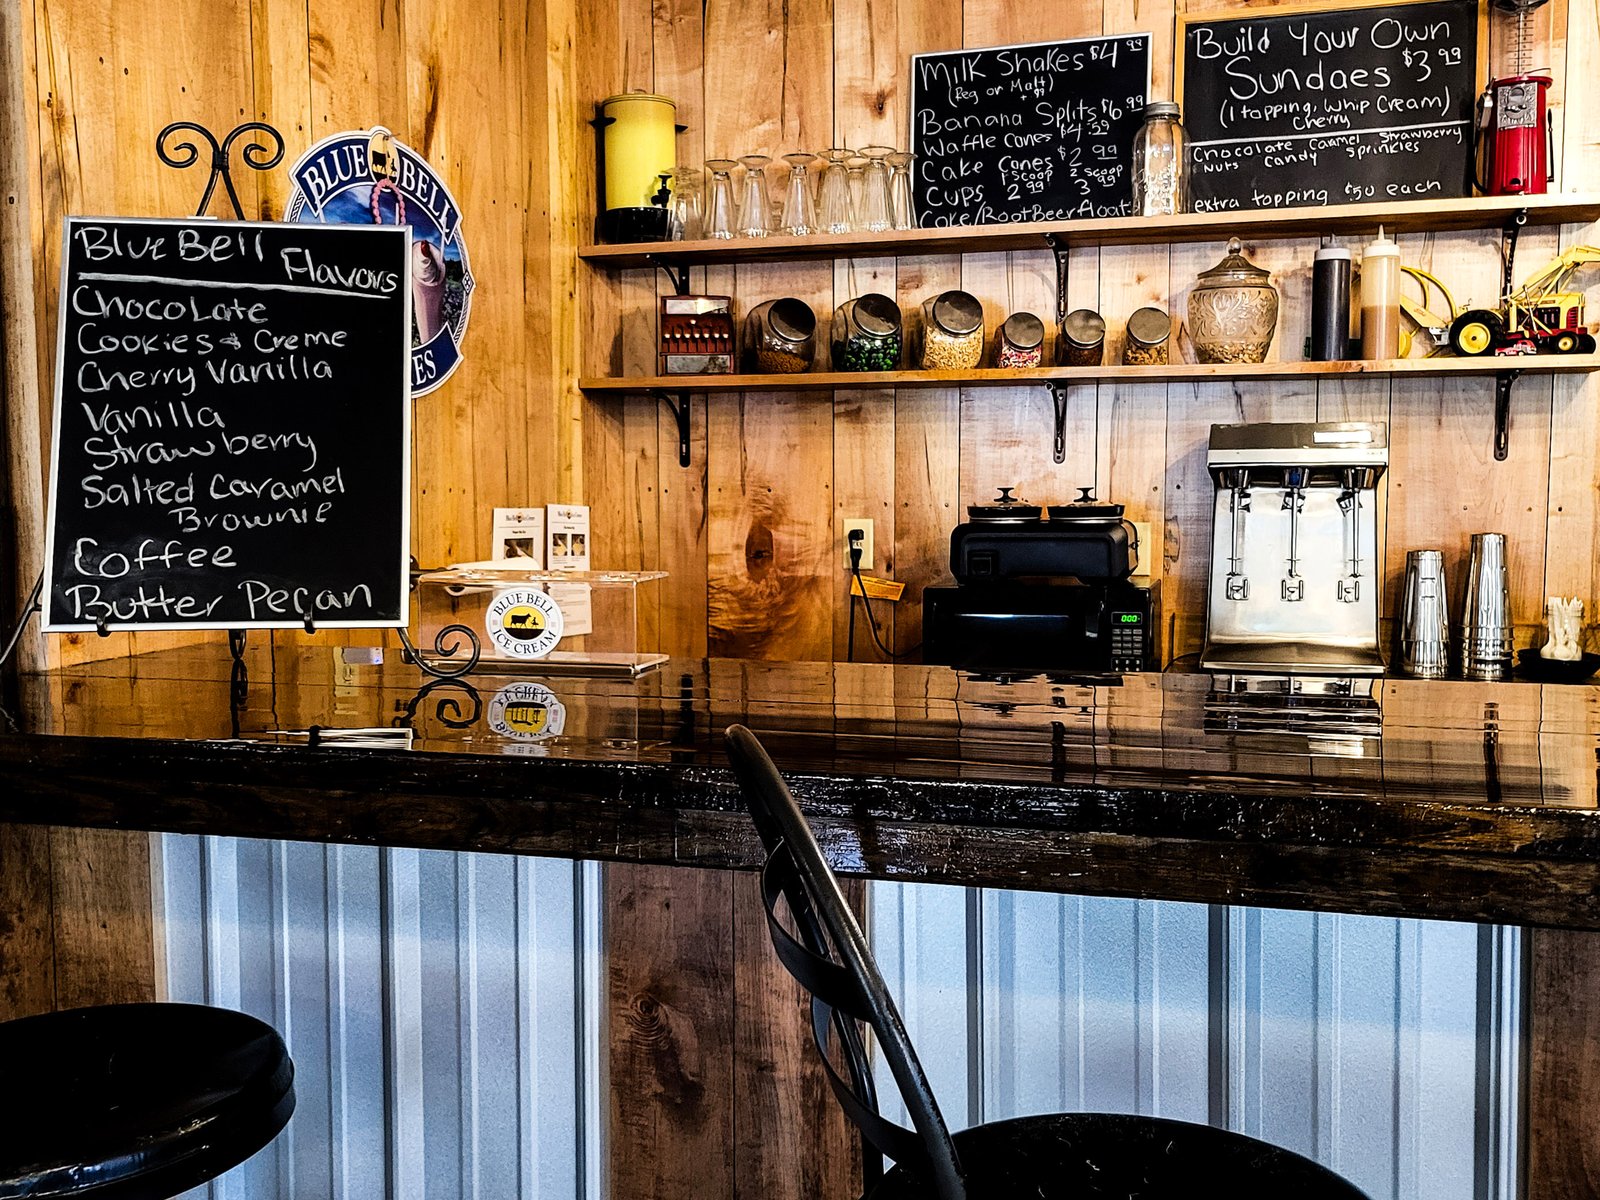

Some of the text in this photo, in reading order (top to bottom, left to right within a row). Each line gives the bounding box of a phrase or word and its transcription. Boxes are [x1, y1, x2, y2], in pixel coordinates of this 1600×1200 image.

[1192, 18, 1450, 60] Build Your Own
[986, 86, 1004, 96] or
[1224, 56, 1391, 100] Sundaes
[918, 108, 1022, 135] Banana
[1035, 99, 1097, 128] Splits
[1293, 113, 1350, 130] Cherry
[922, 133, 997, 157] Waffle
[1193, 140, 1293, 164] Chocolate
[922, 157, 983, 183] Cake
[998, 155, 1054, 173] Cones
[1070, 168, 1078, 177] 2
[301, 144, 454, 234] BLUE BELL
[1194, 198, 1240, 214] extra
[1252, 189, 1328, 207] topping
[1386, 180, 1441, 196] each
[75, 226, 399, 293] Blue Bell Flavors
[78, 323, 214, 355] Cookies
[253, 328, 348, 354] Creme
[77, 354, 334, 396] Cherry Vanilla
[80, 400, 226, 435] Vanilla
[83, 431, 317, 473] Strawberry
[80, 466, 346, 509] Salted Caramel
[168, 500, 333, 533] Brownie
[73, 537, 237, 579] Coffee
[64, 579, 372, 621] Butter Pecan
[493, 593, 524, 616] BLUE
[526, 593, 552, 618] BELL
[493, 629, 556, 654] ICE CREAM
